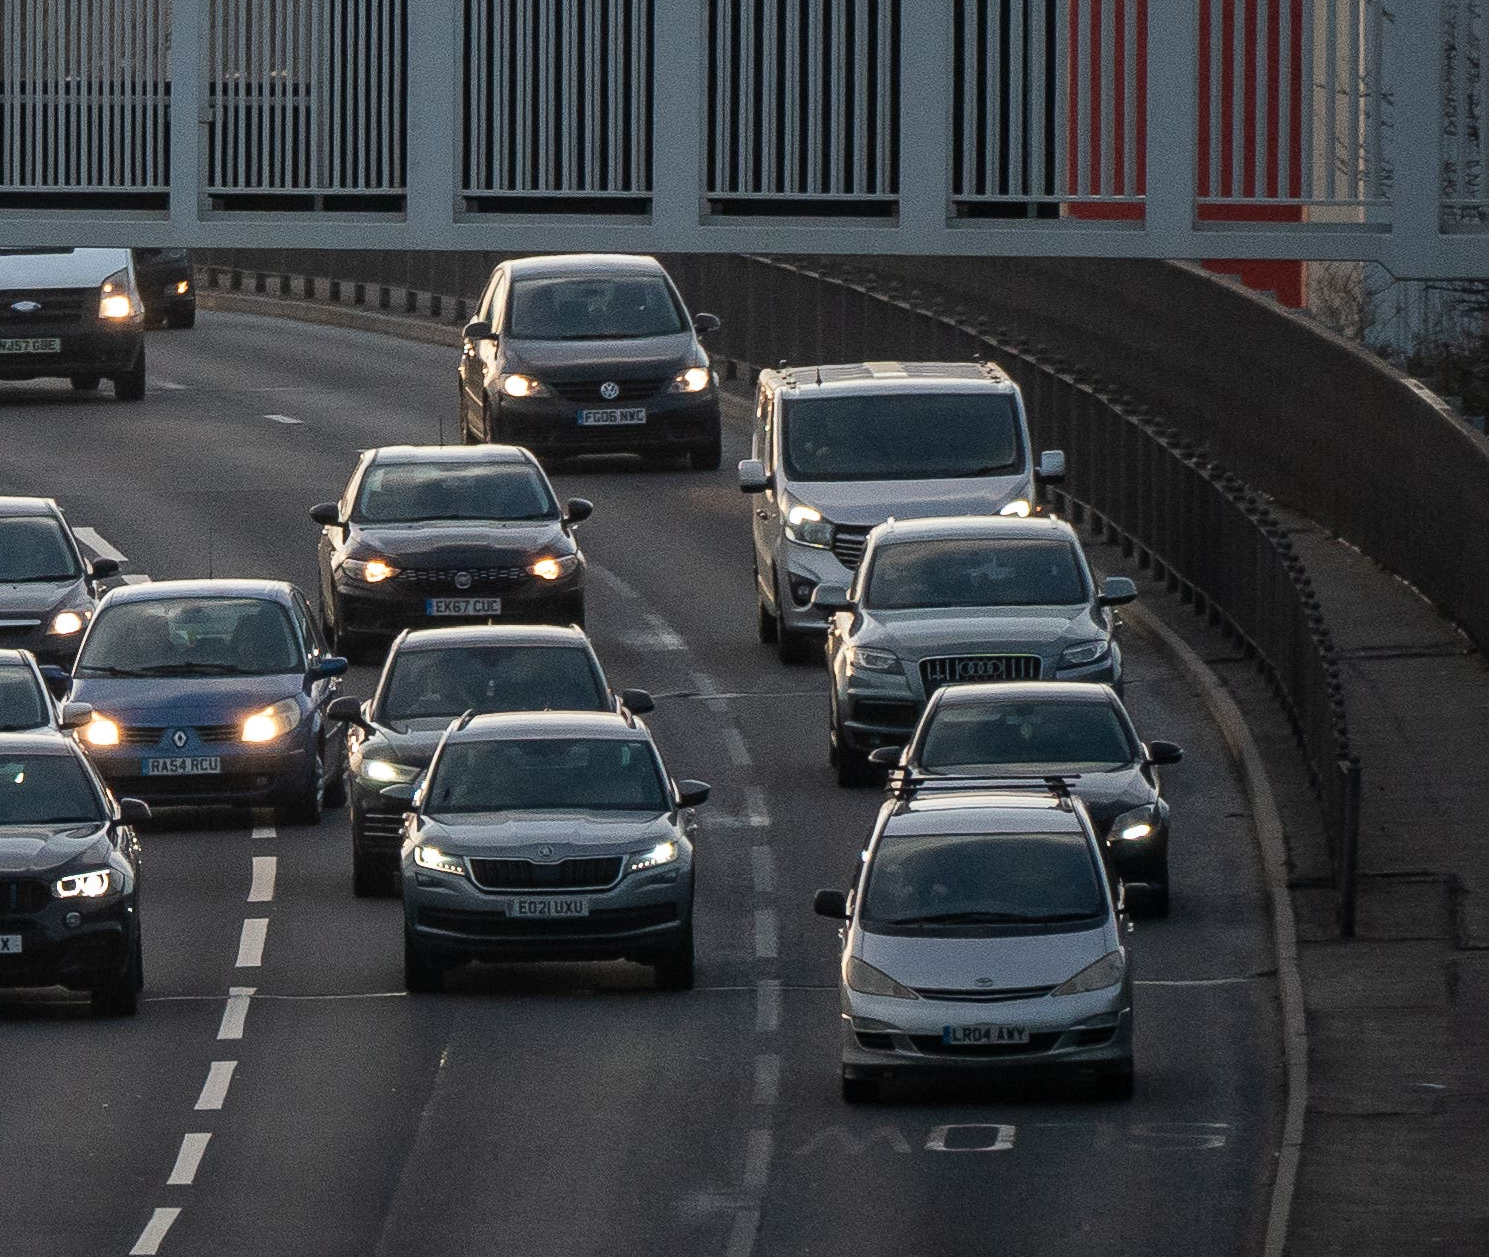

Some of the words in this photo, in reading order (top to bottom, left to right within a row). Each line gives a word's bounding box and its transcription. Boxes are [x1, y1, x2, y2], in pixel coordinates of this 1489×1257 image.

[435, 600, 471, 613] EK67
[151, 759, 187, 773] RA54
[190, 758, 219, 772] RCU
[554, 900, 584, 914] UXU
[952, 1027, 992, 1042] LR04
